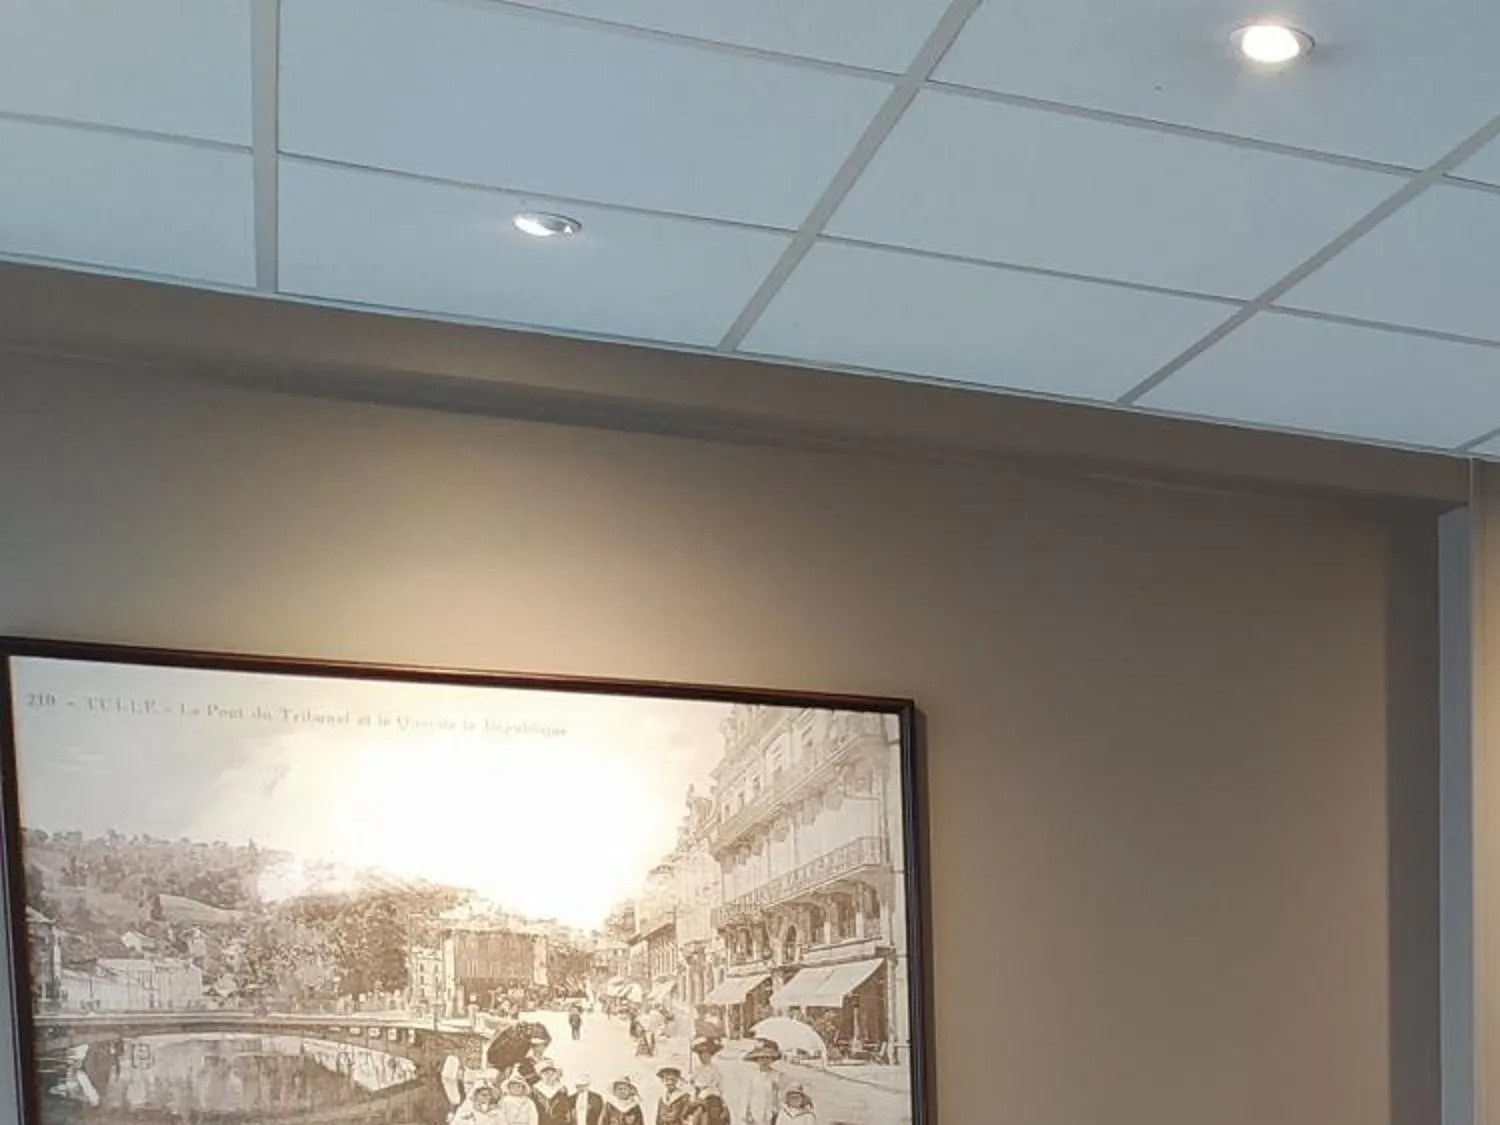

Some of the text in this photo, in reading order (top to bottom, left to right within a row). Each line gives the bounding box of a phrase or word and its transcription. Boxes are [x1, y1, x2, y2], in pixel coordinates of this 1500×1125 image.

[26, 693, 56, 707] 210
[206, 703, 243, 719] Pont
[250, 705, 274, 721] du
[279, 707, 350, 725] Tribunal
